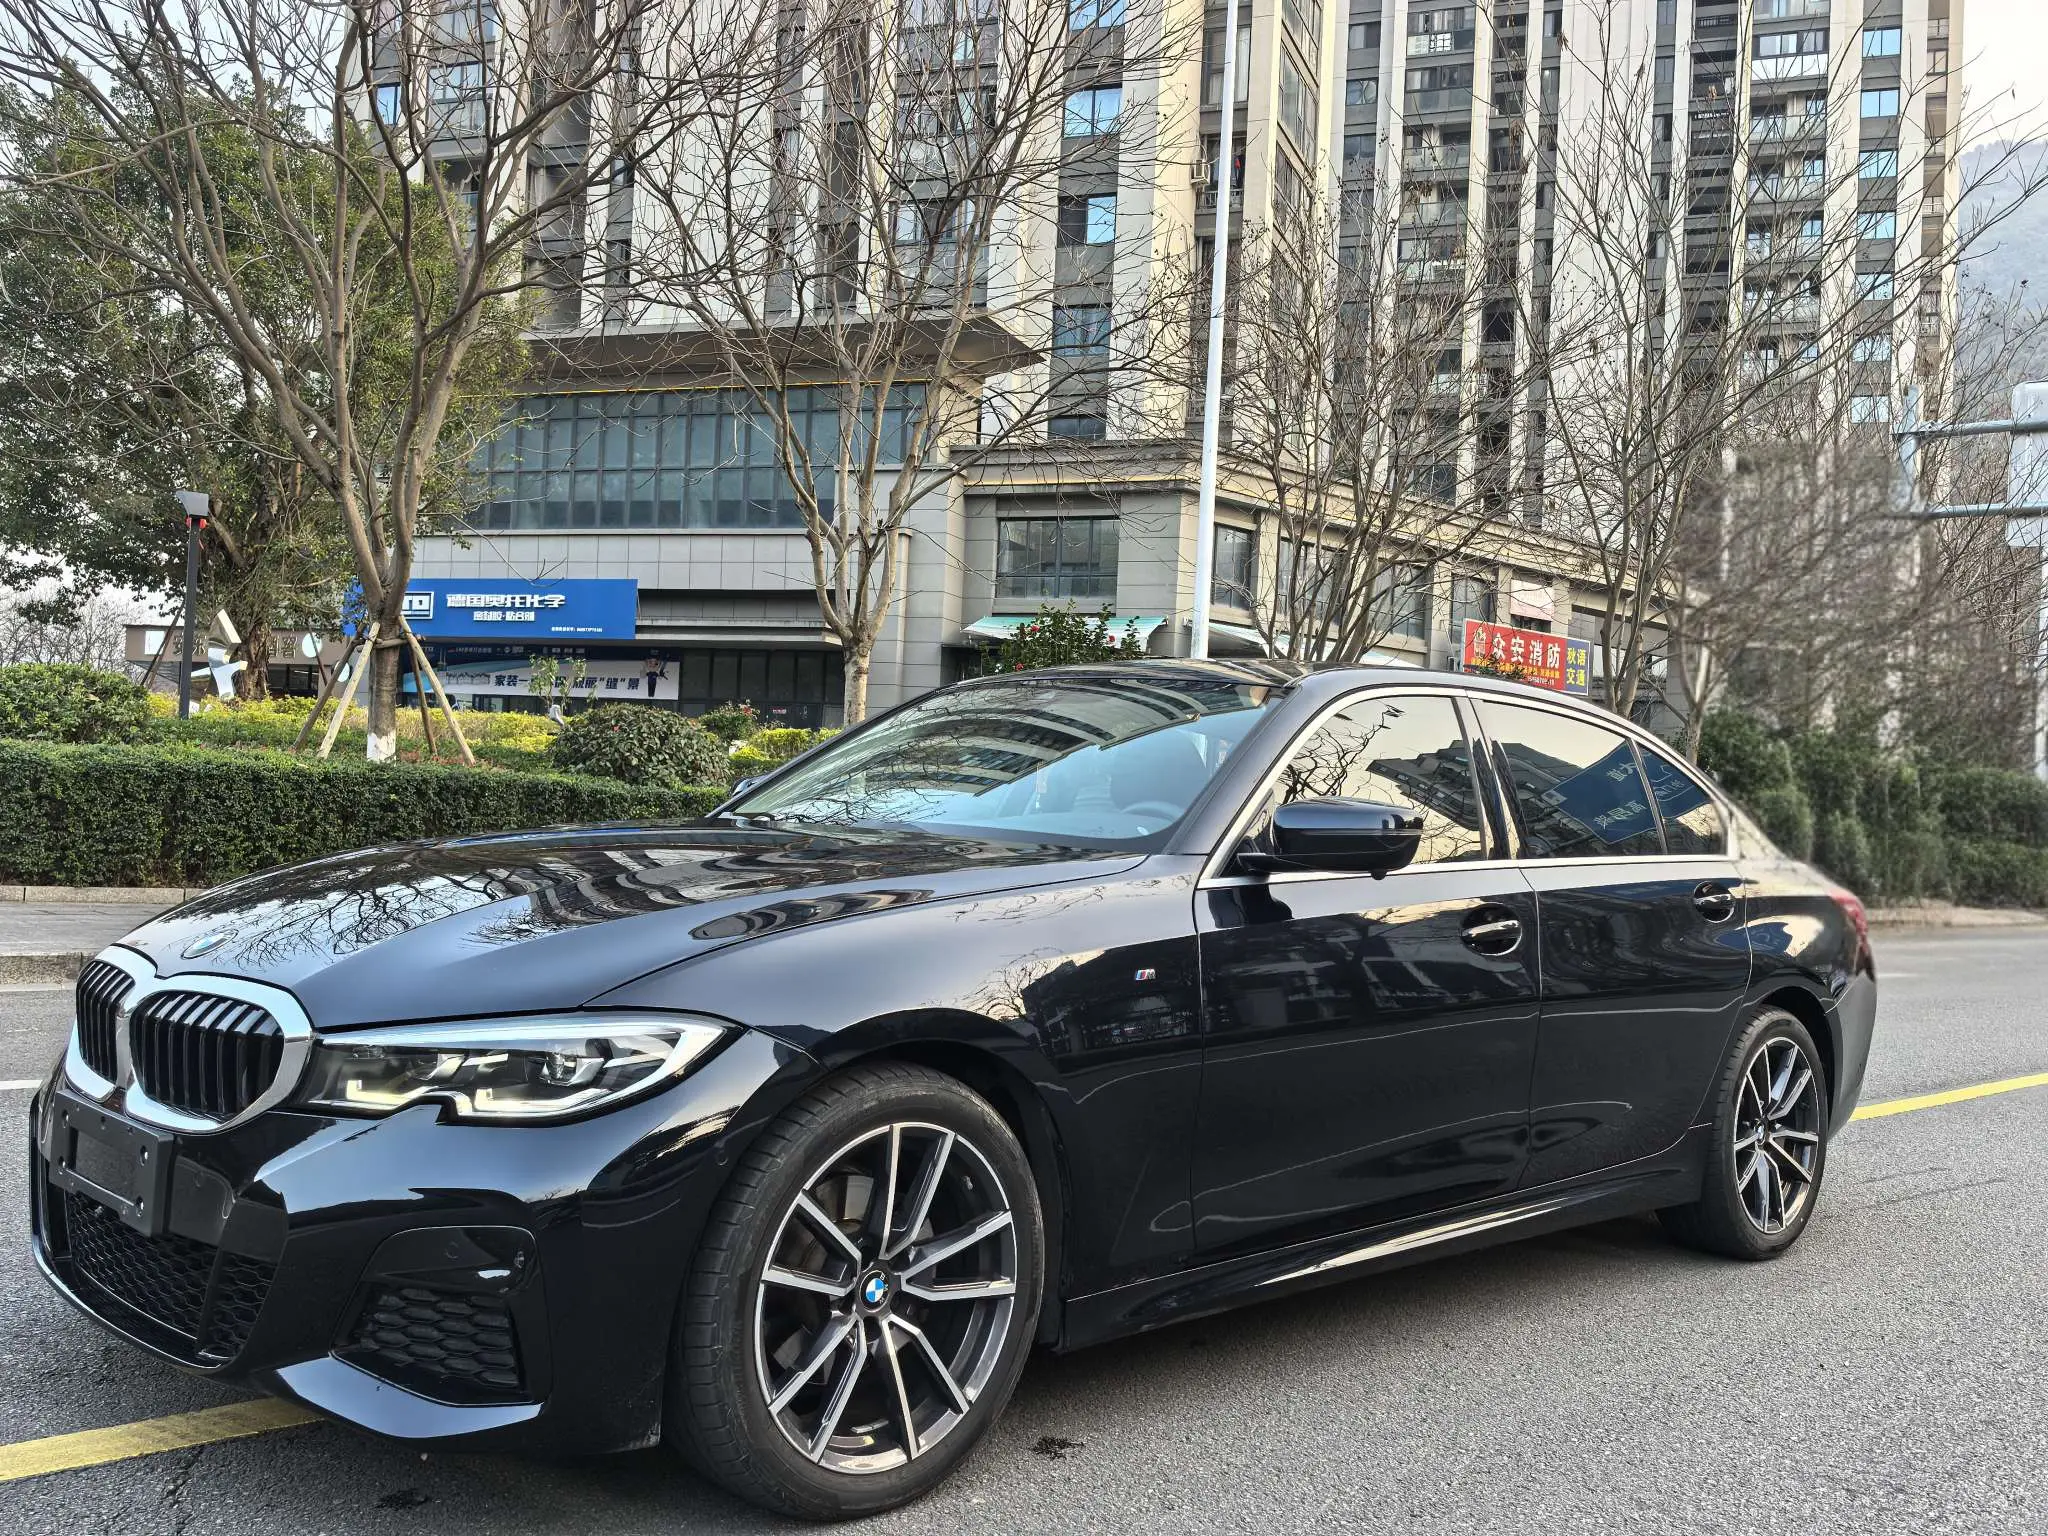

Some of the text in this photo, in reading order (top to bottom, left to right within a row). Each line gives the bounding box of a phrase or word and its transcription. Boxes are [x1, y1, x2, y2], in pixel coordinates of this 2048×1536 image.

[1492, 632, 1561, 668] 众安消防
[1566, 667, 1586, 687] 交通
